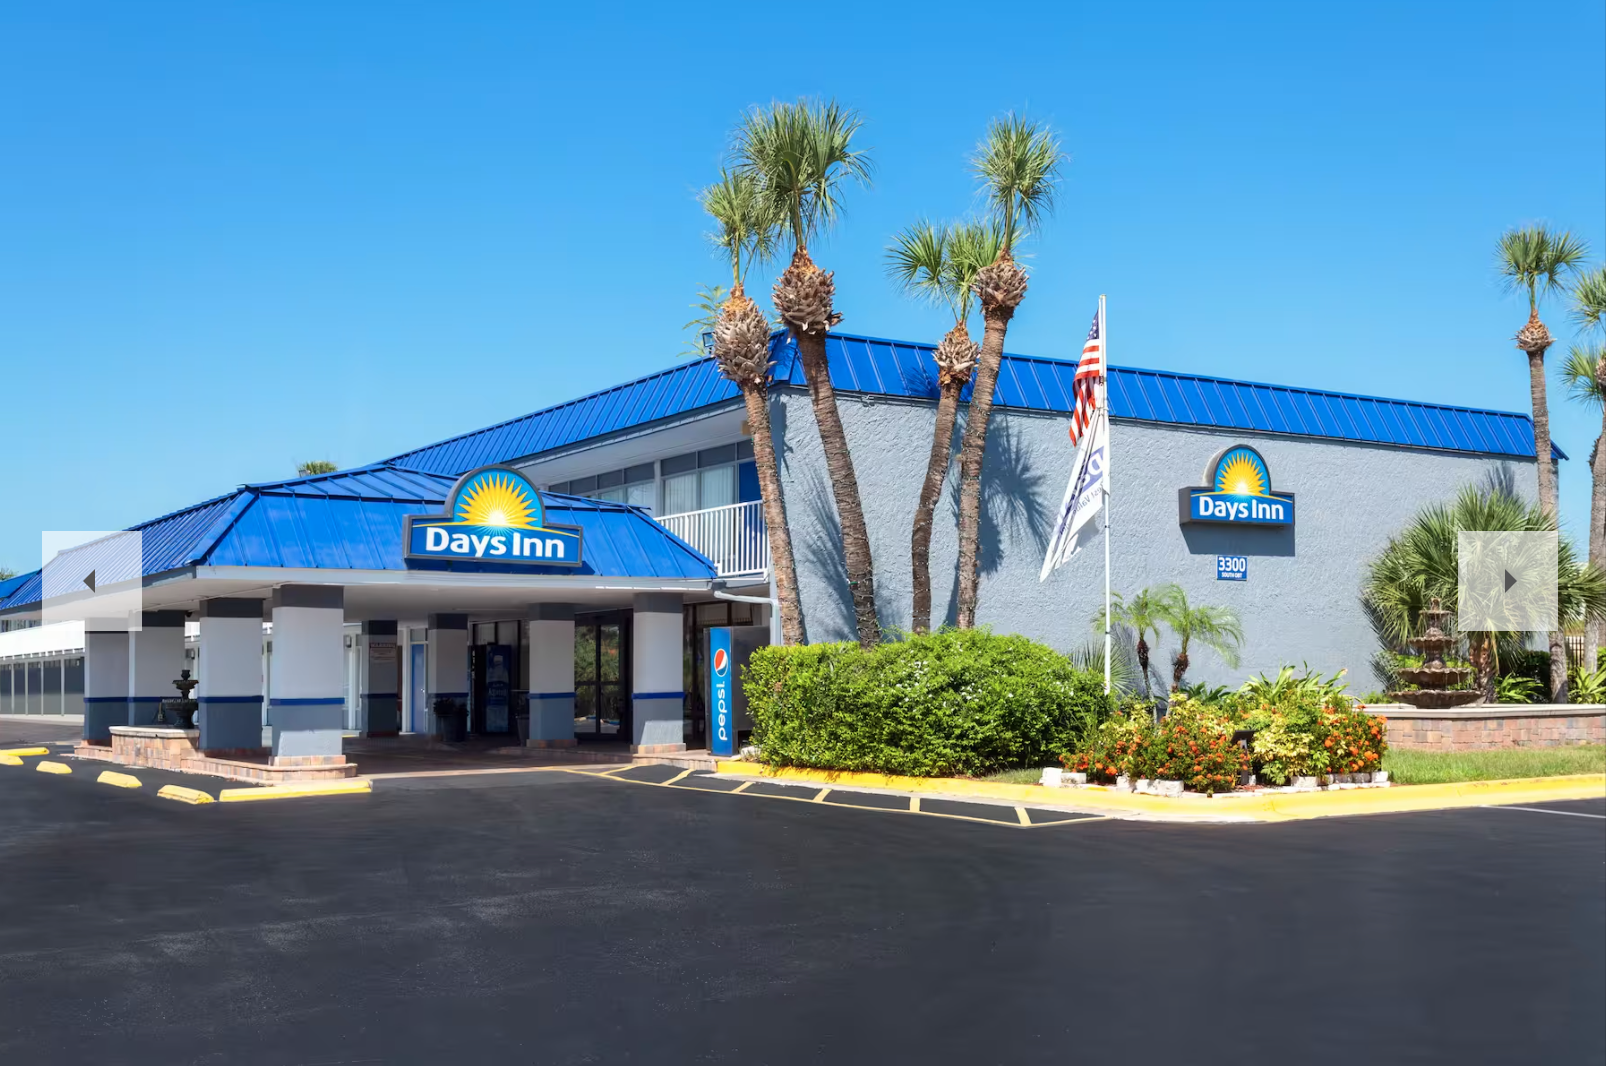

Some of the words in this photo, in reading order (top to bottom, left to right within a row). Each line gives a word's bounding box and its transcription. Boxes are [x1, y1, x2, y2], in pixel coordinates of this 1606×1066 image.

[1199, 496, 1249, 520] Days
[1251, 499, 1284, 520] Inn
[425, 526, 507, 558] Days
[512, 532, 565, 558] Inn
[1218, 556, 1246, 572] 3300
[716, 683, 728, 741] pepsi
